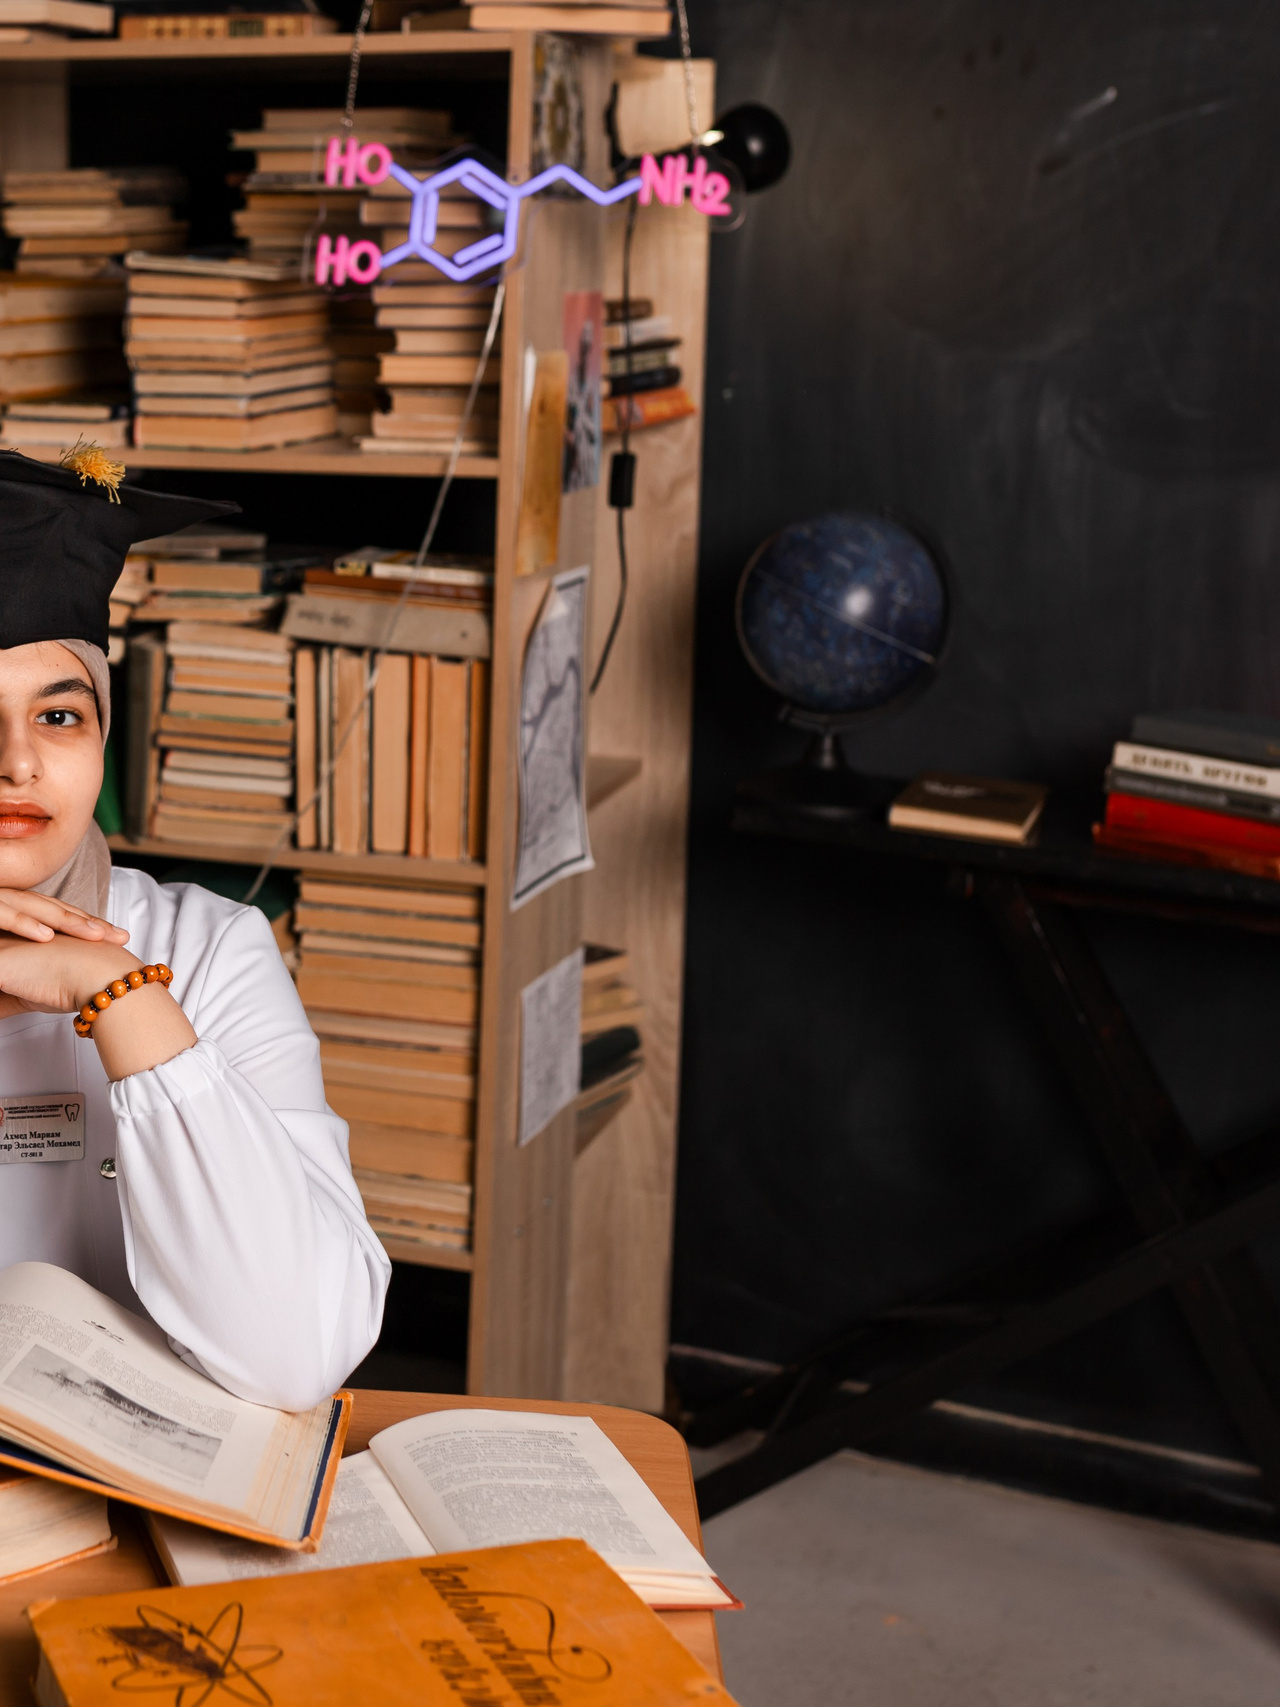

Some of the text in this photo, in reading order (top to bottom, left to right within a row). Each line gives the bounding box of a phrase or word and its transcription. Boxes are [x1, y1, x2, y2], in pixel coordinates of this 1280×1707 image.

[324, 134, 394, 189] HO
[314, 233, 383, 287] HO
[3, 1131, 61, 1140] Ахмед Мариам
[46, 1140, 81, 1148] Мохамед
